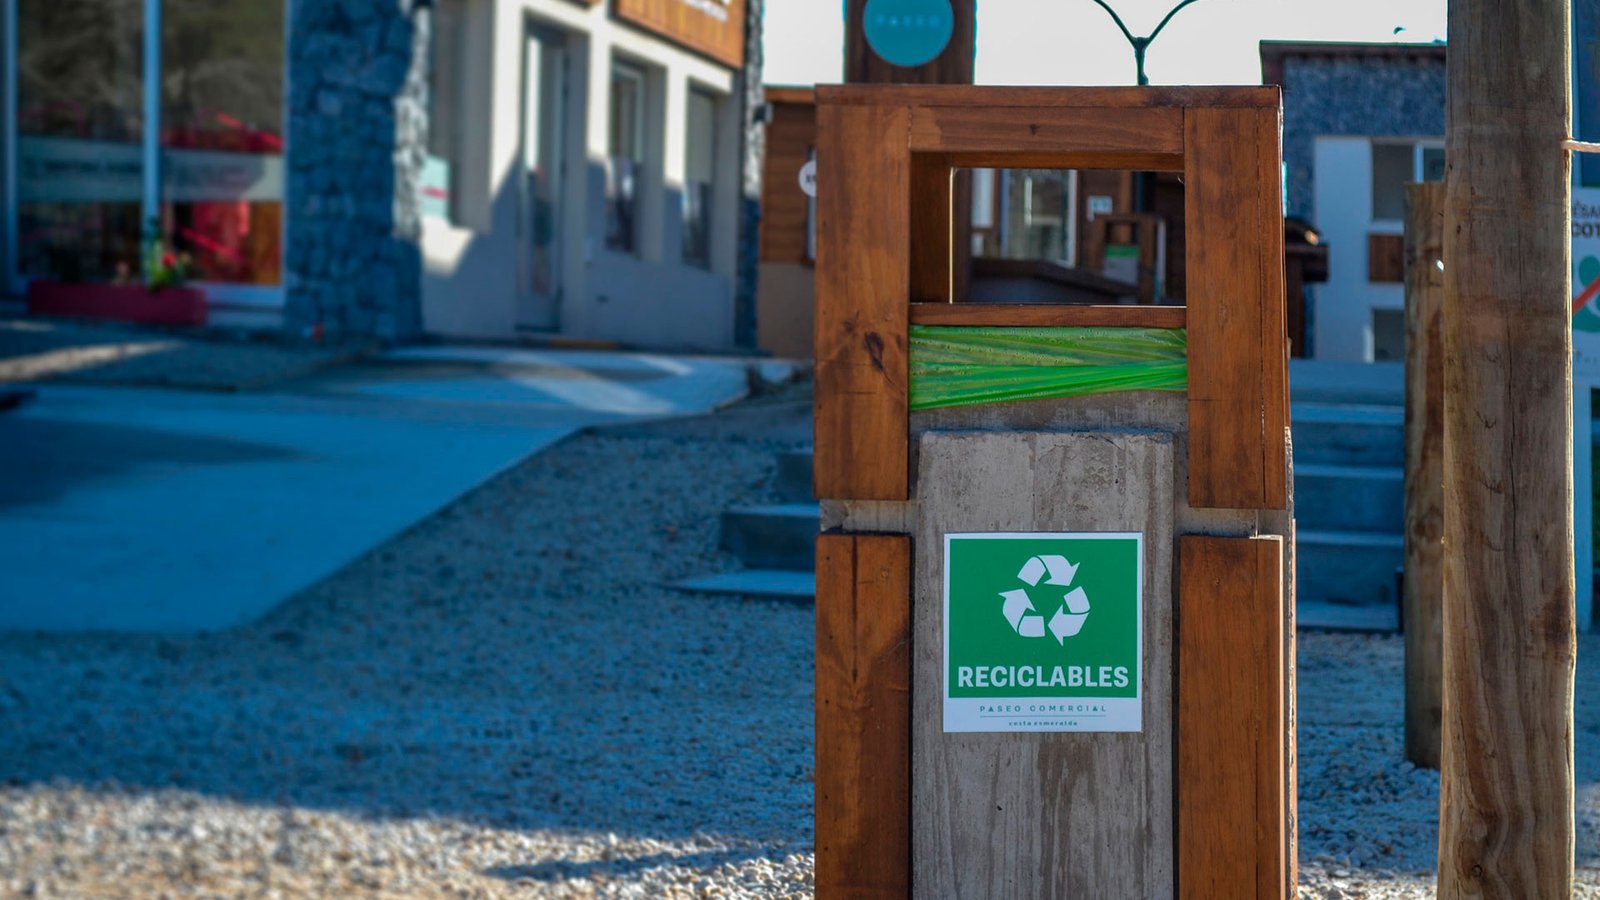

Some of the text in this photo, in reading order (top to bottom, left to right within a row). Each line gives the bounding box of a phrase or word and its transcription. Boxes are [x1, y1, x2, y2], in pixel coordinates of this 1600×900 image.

[957, 665, 1129, 688] RECICLABLES
[980, 704, 1106, 713] PASEO COMERCIAL
